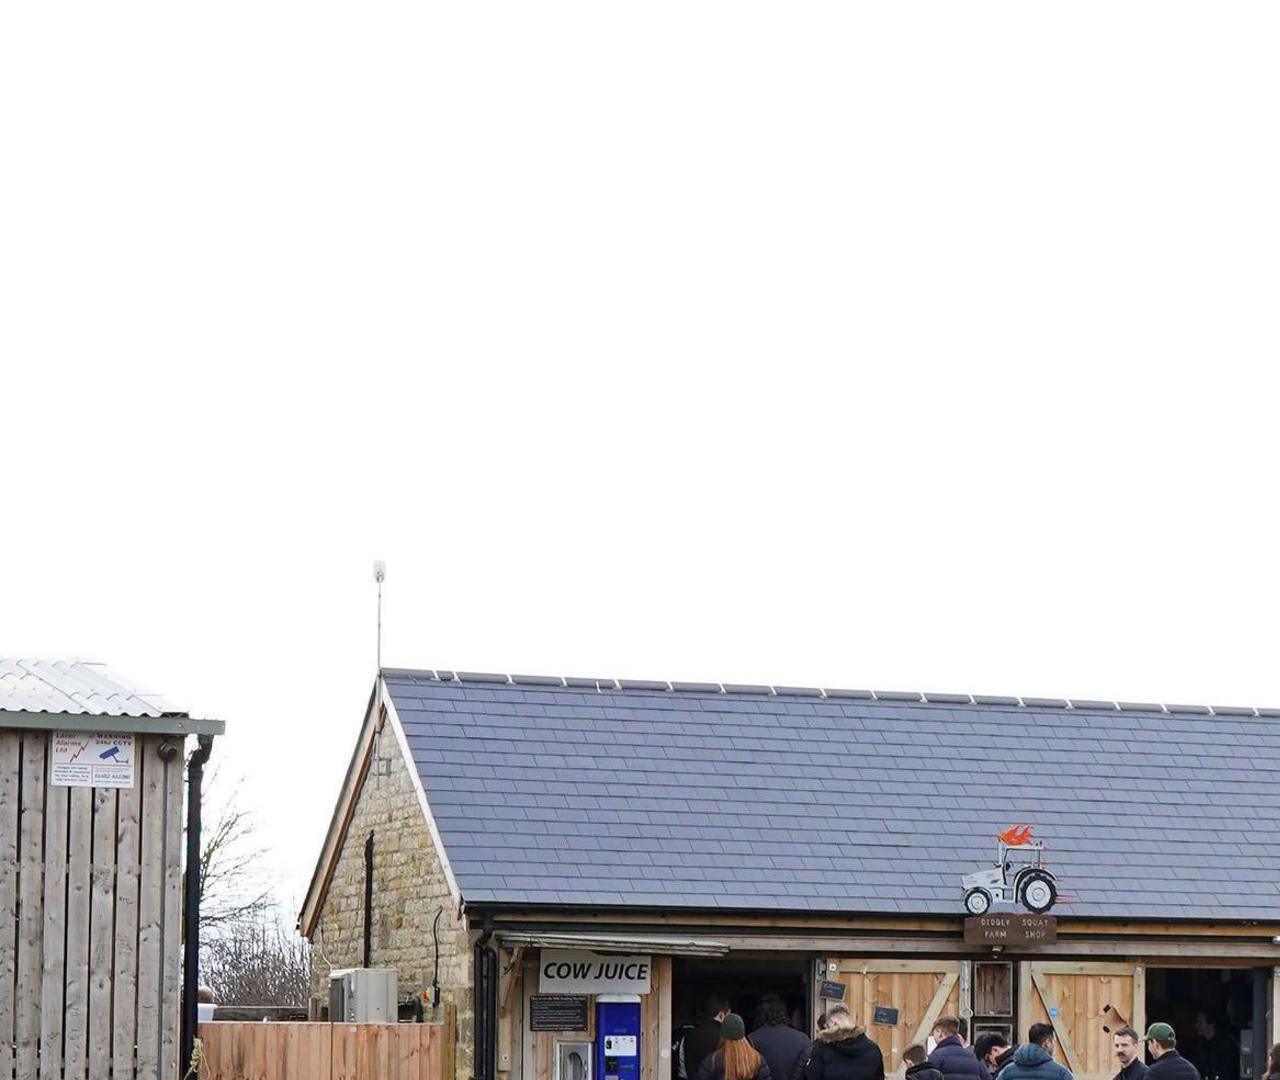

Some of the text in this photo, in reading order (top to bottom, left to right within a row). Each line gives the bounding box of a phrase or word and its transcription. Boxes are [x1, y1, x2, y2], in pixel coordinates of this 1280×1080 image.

[1022, 918, 1049, 927] SQUAT
[984, 930, 1046, 939] FARM SHOP
[543, 962, 649, 980] COW JUICE
